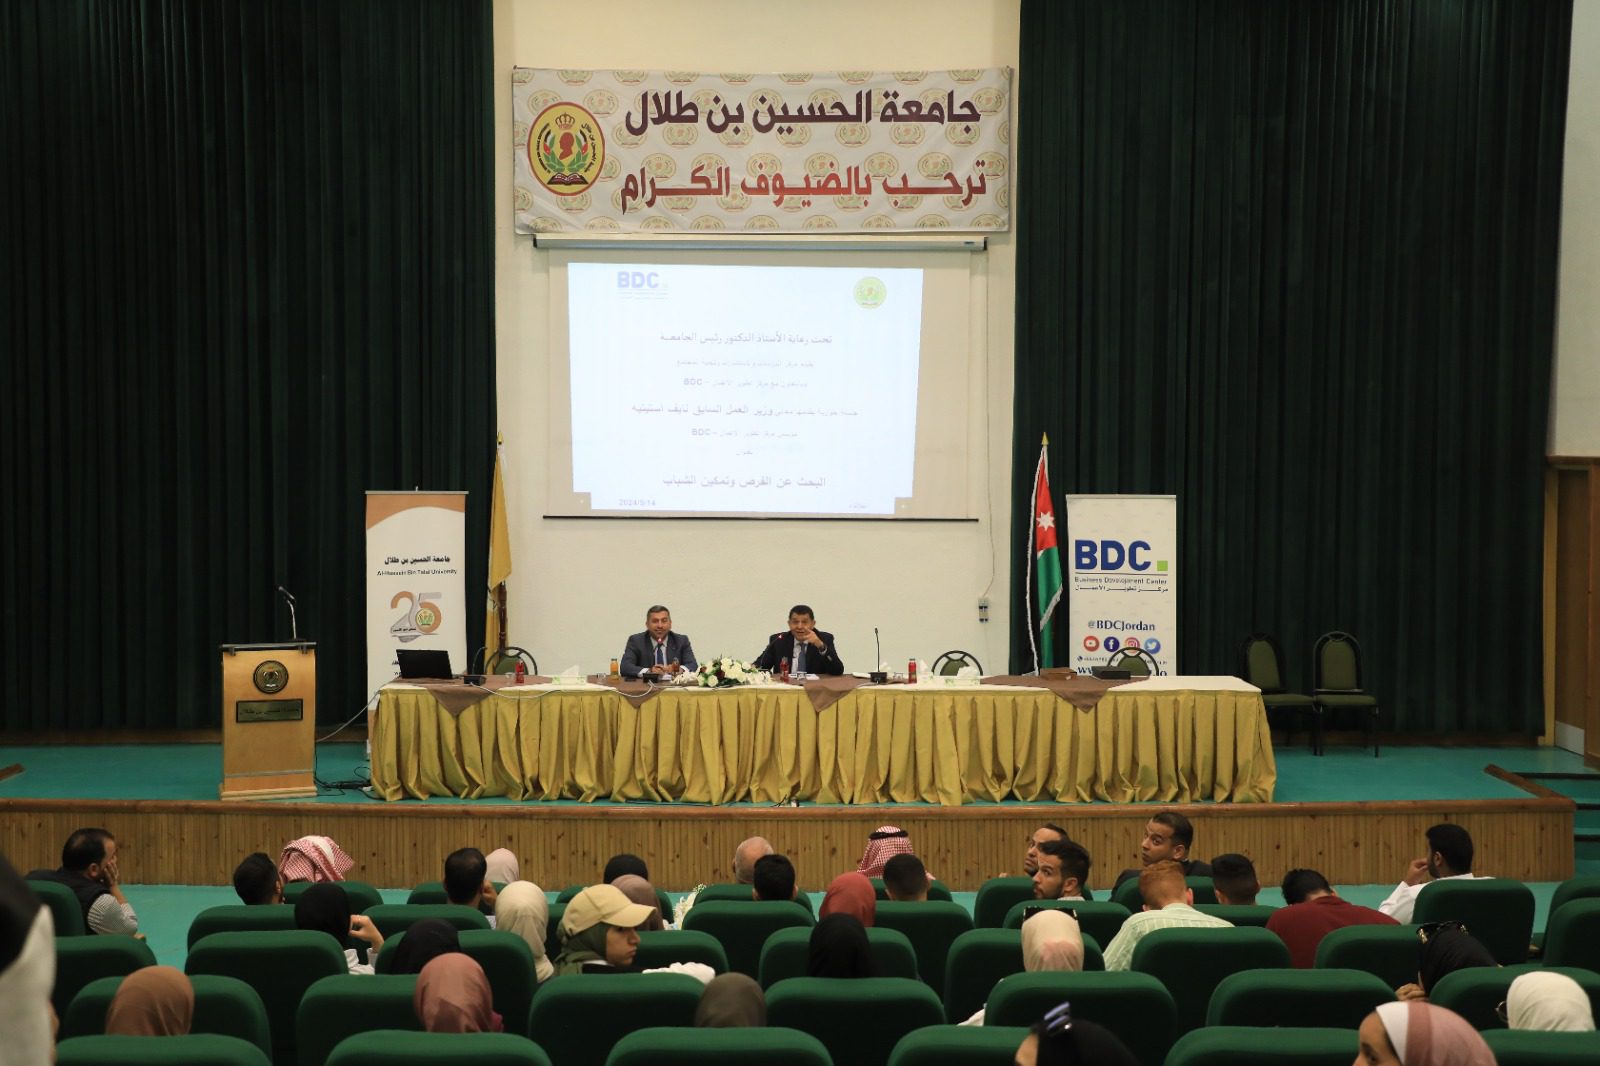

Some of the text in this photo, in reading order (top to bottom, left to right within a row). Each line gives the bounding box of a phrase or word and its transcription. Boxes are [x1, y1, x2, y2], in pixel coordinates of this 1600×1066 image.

[625, 89, 981, 136] جامعة الحسين بن طلال
[620, 160, 987, 215] ترحب بالضيوف الكرام
